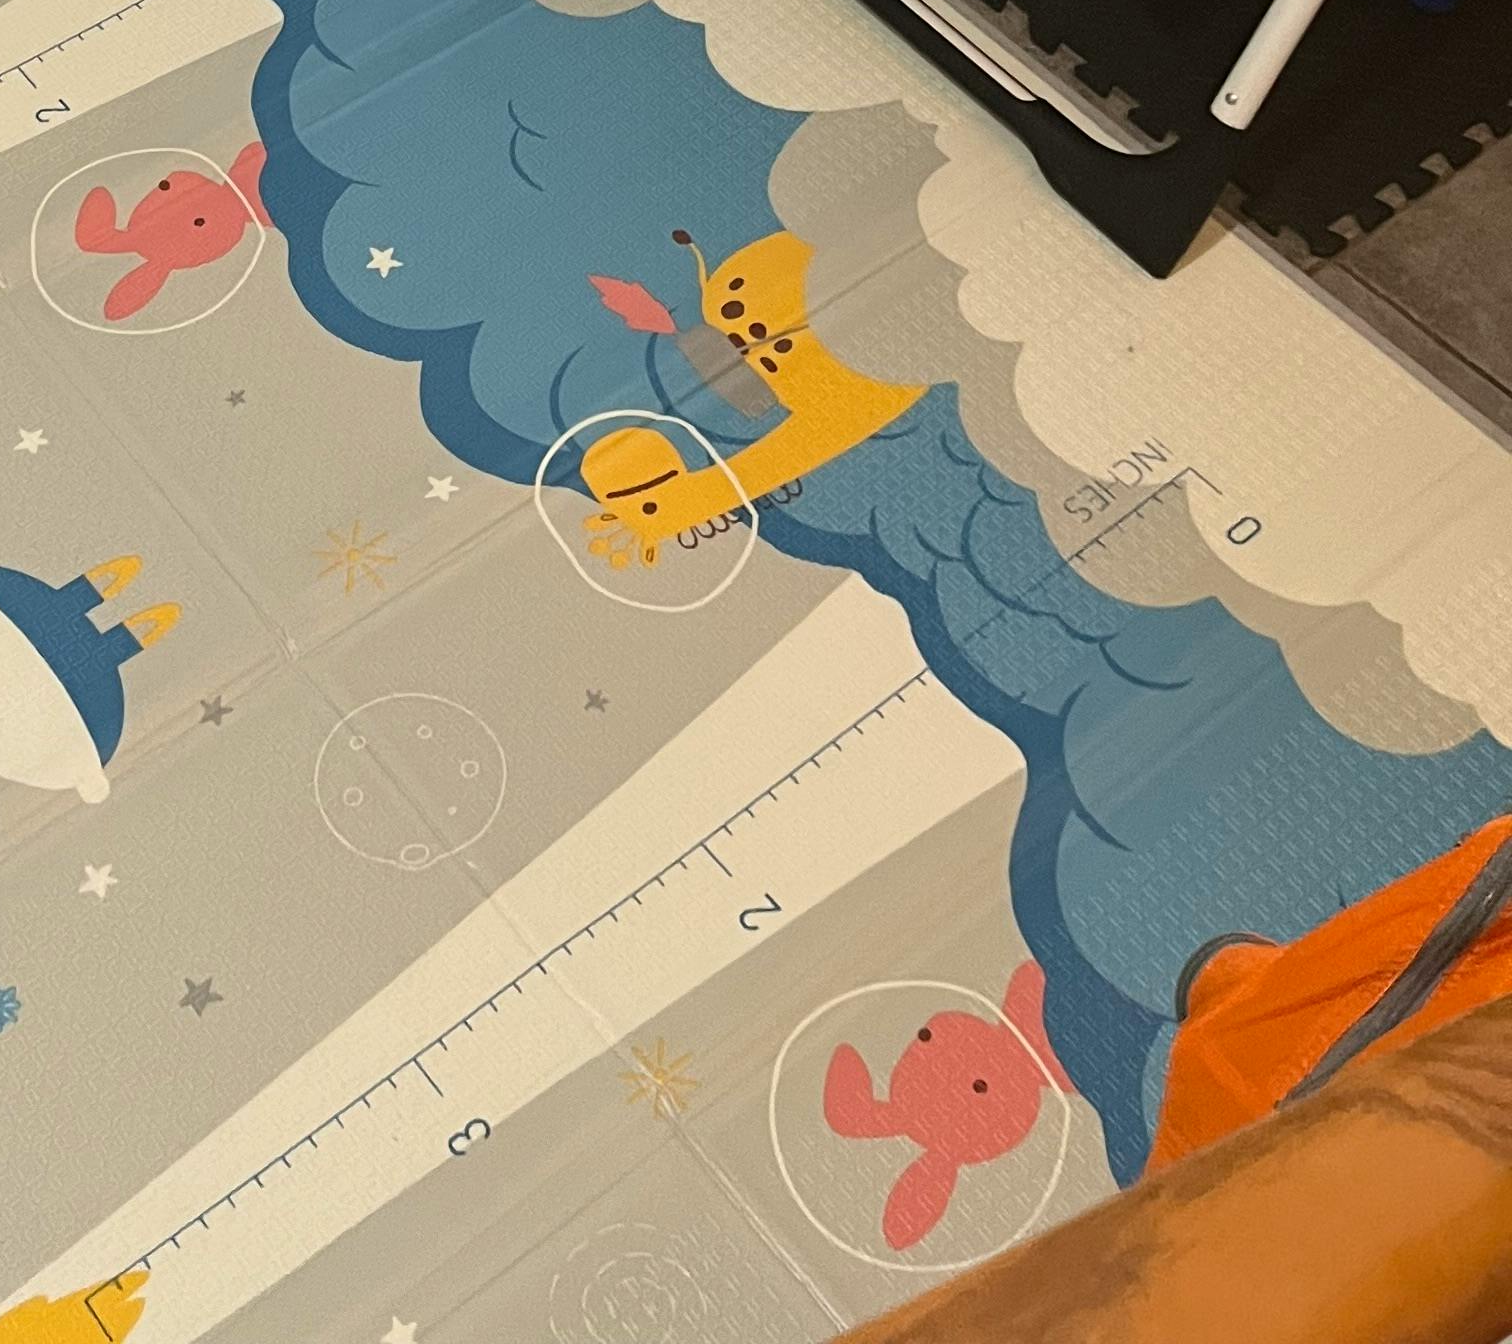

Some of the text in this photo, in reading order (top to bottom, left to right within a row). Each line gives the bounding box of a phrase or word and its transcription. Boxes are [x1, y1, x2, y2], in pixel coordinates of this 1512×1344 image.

[35, 98, 71, 124] 2
[1063, 436, 1174, 524] INCHES
[1226, 516, 1262, 545] 0
[738, 892, 782, 931] 2
[447, 1117, 492, 1156] 3
